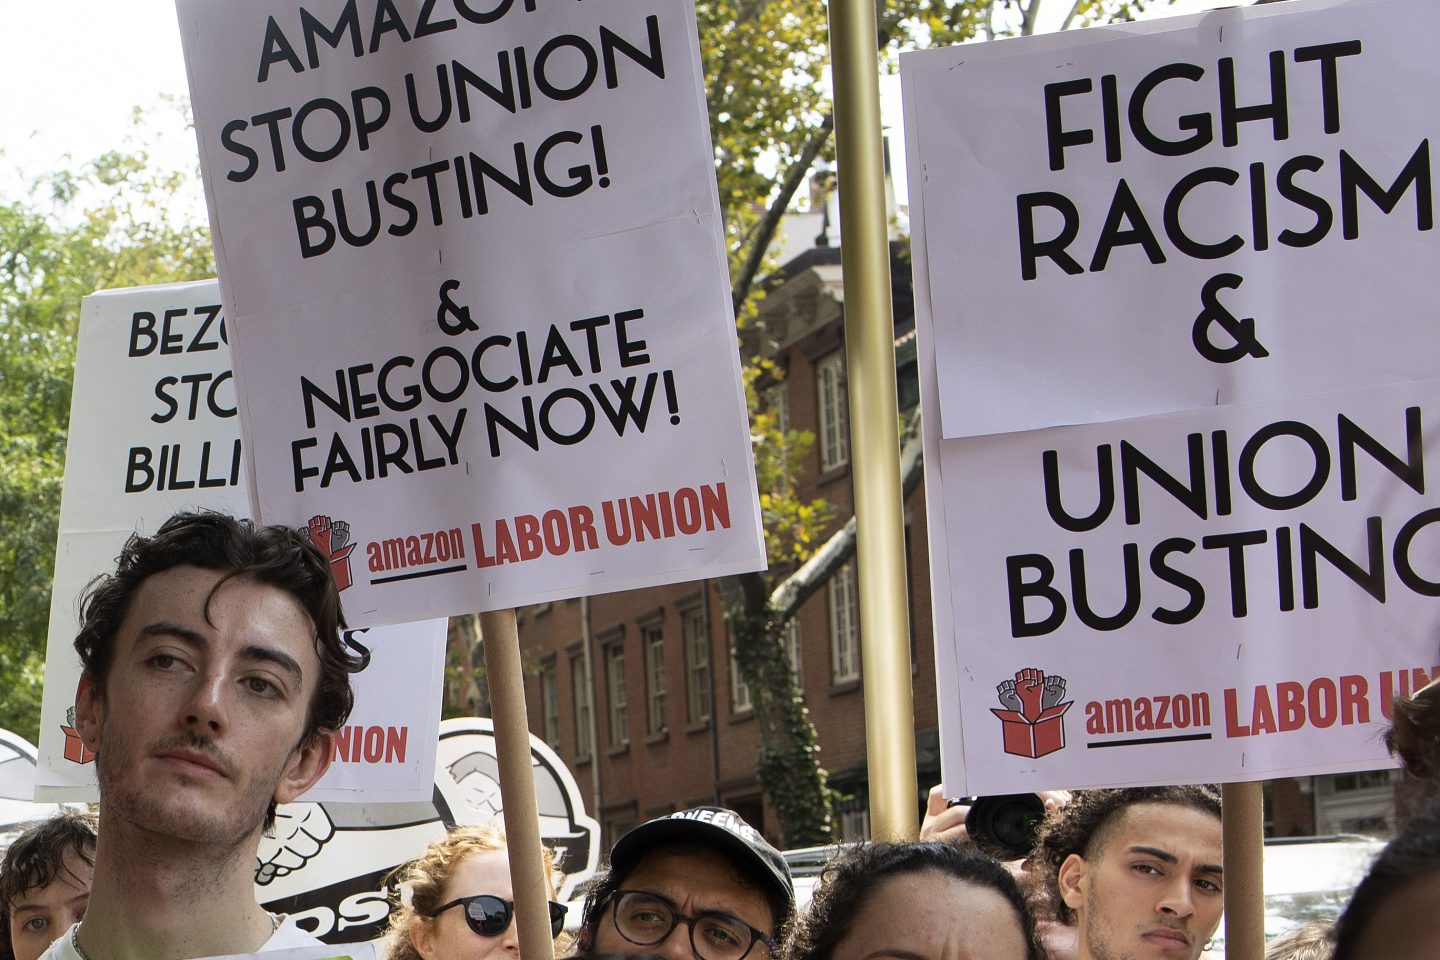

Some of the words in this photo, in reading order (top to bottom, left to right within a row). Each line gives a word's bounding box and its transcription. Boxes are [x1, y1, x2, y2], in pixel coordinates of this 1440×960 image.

[220, 85, 391, 183] STOP
[407, 15, 665, 134] UNION
[257, 0, 581, 83] AMAZ
[1043, 40, 1362, 171] FIGHT
[292, 124, 611, 259] BUSTING!
[1016, 138, 1433, 281] RACISM
[128, 304, 229, 357] BEZ
[437, 278, 479, 335] &
[1192, 273, 1269, 364] &
[300, 308, 650, 429] NEGOCIATE
[290, 407, 468, 493] FAIRLY
[485, 369, 682, 458] NOW!
[1042, 406, 1425, 533] UNION
[366, 527, 465, 572] amazon
[471, 505, 599, 568] LABOR
[601, 482, 731, 546] UNION
[1084, 688, 1211, 736] amazon
[1223, 672, 1371, 739] LABOR
